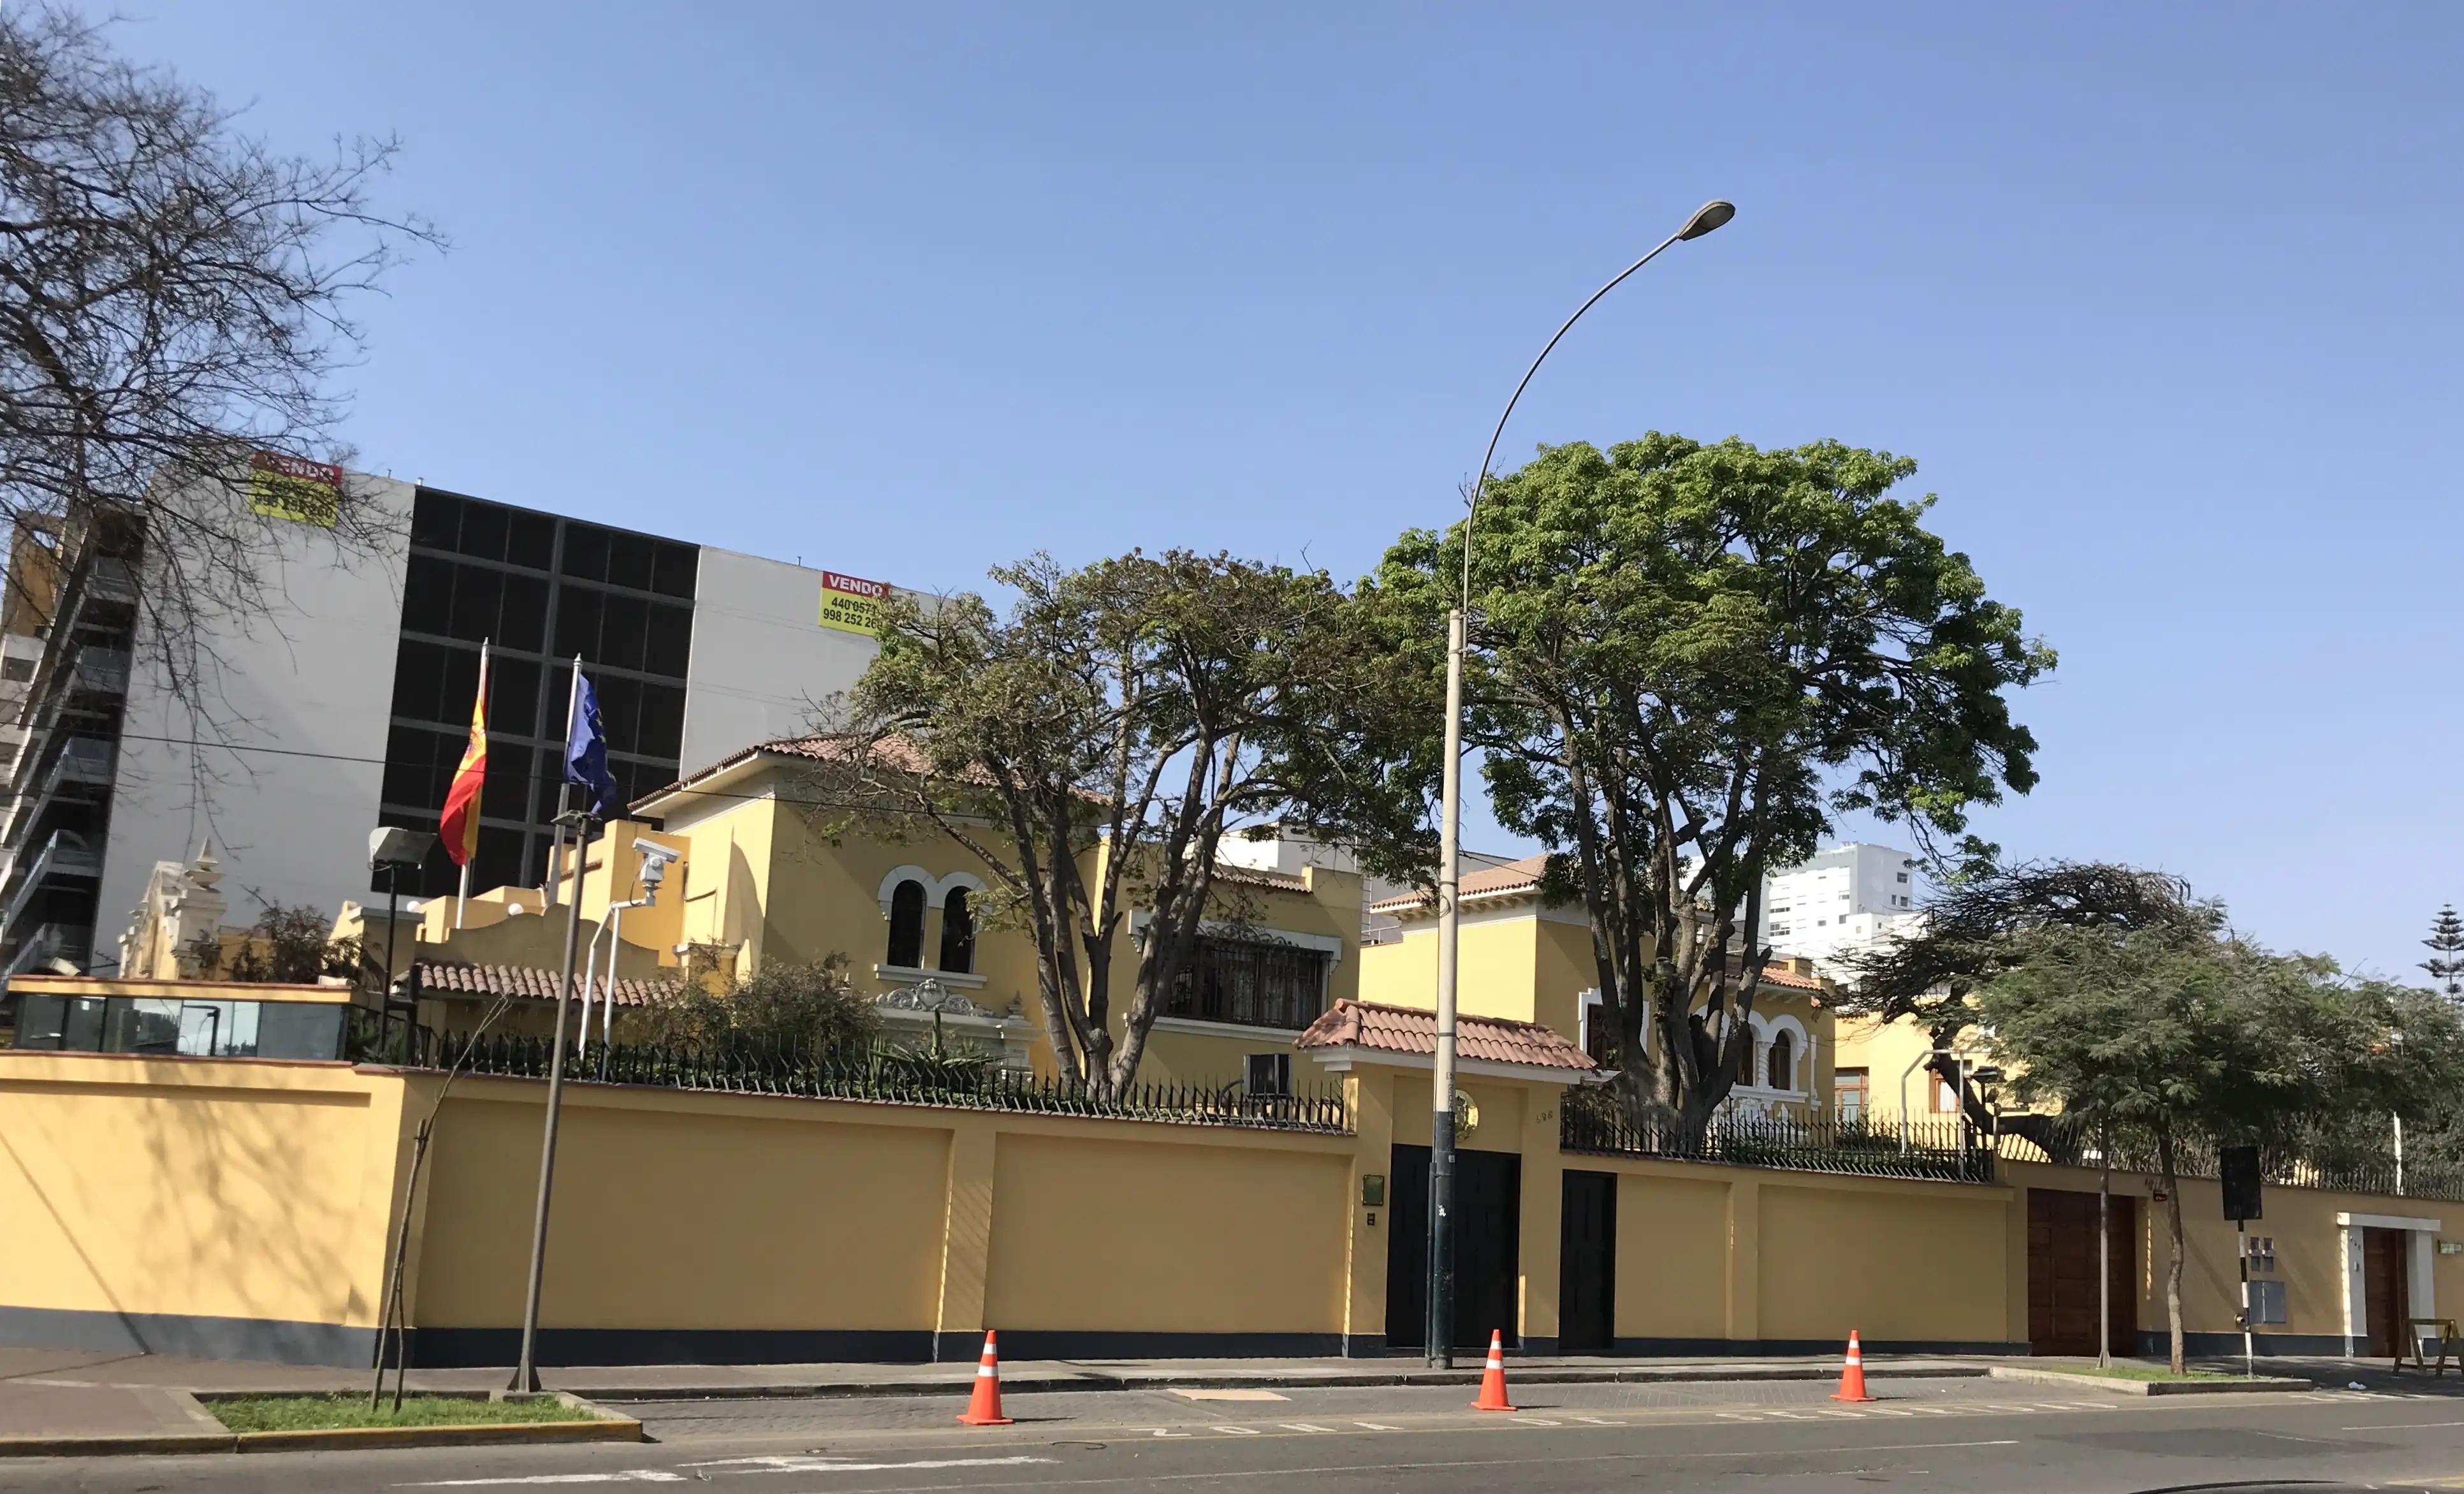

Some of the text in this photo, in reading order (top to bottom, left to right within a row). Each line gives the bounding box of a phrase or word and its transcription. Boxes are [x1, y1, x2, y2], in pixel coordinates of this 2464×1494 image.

[829, 574, 884, 596] VENDO
[823, 608, 842, 622] 998
[843, 612, 863, 626] 252
